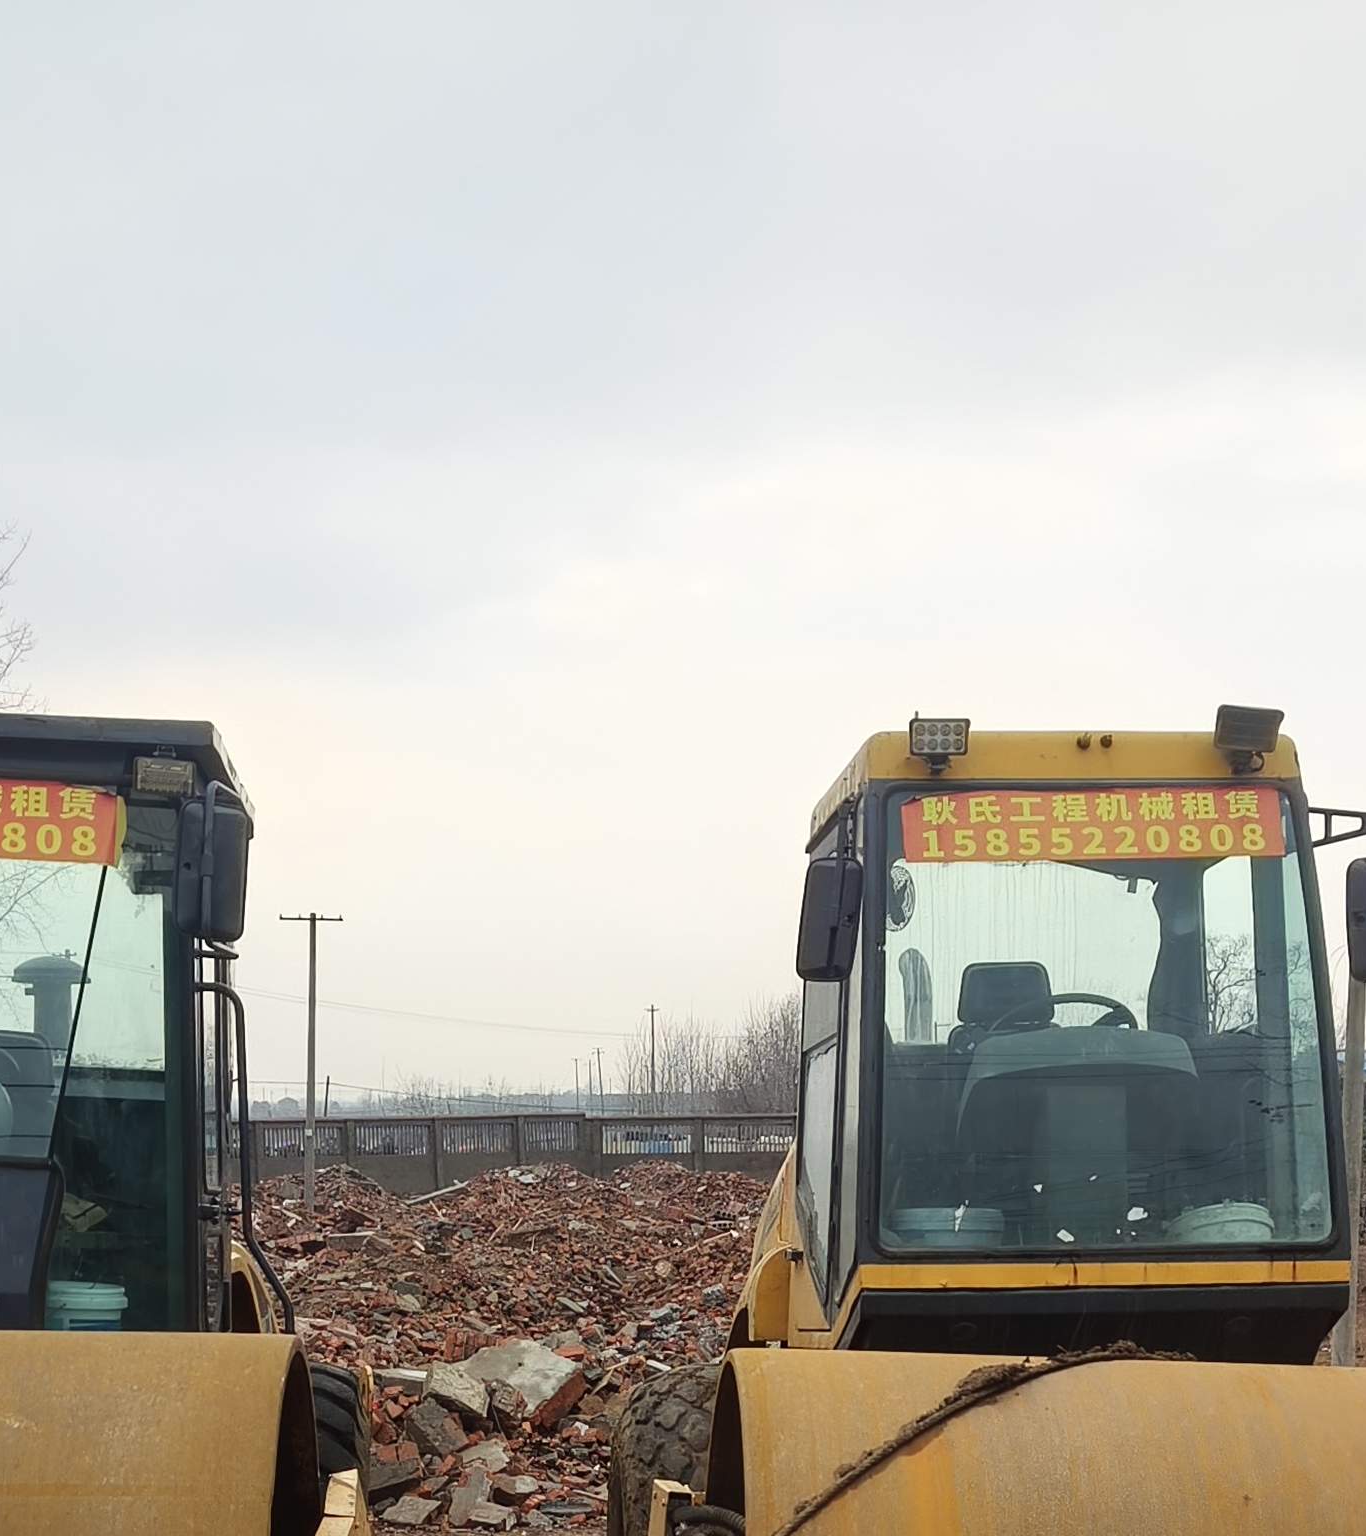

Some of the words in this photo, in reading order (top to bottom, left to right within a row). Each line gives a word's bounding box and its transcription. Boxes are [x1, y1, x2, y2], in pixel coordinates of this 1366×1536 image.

[921, 791, 1261, 825] 耿氏工程机械租赁
[922, 823, 1267, 858] 15855220808
